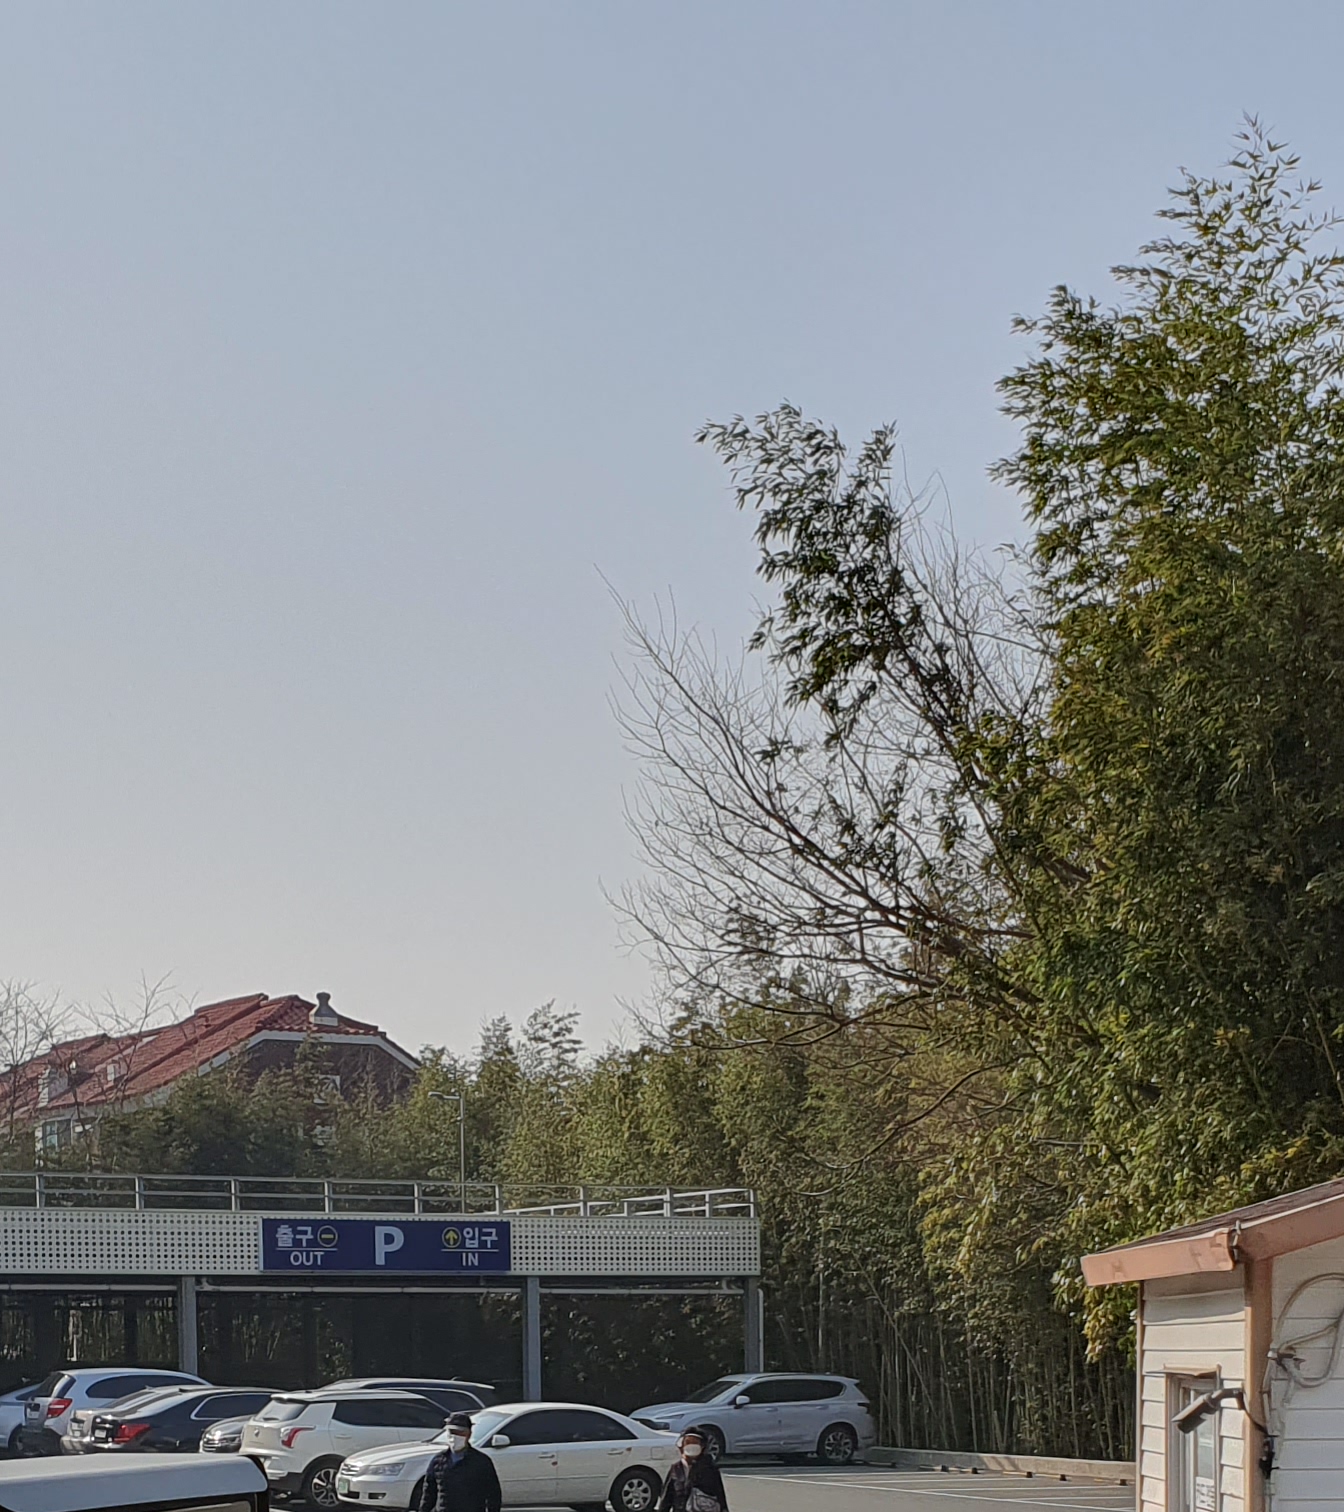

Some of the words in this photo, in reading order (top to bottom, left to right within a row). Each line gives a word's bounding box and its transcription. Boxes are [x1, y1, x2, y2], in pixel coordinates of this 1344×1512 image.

[276, 1225, 314, 1247] 출구
[374, 1226, 404, 1265] P
[463, 1227, 498, 1248] 입구
[289, 1252, 324, 1266] OUT
[462, 1252, 479, 1266] IN
